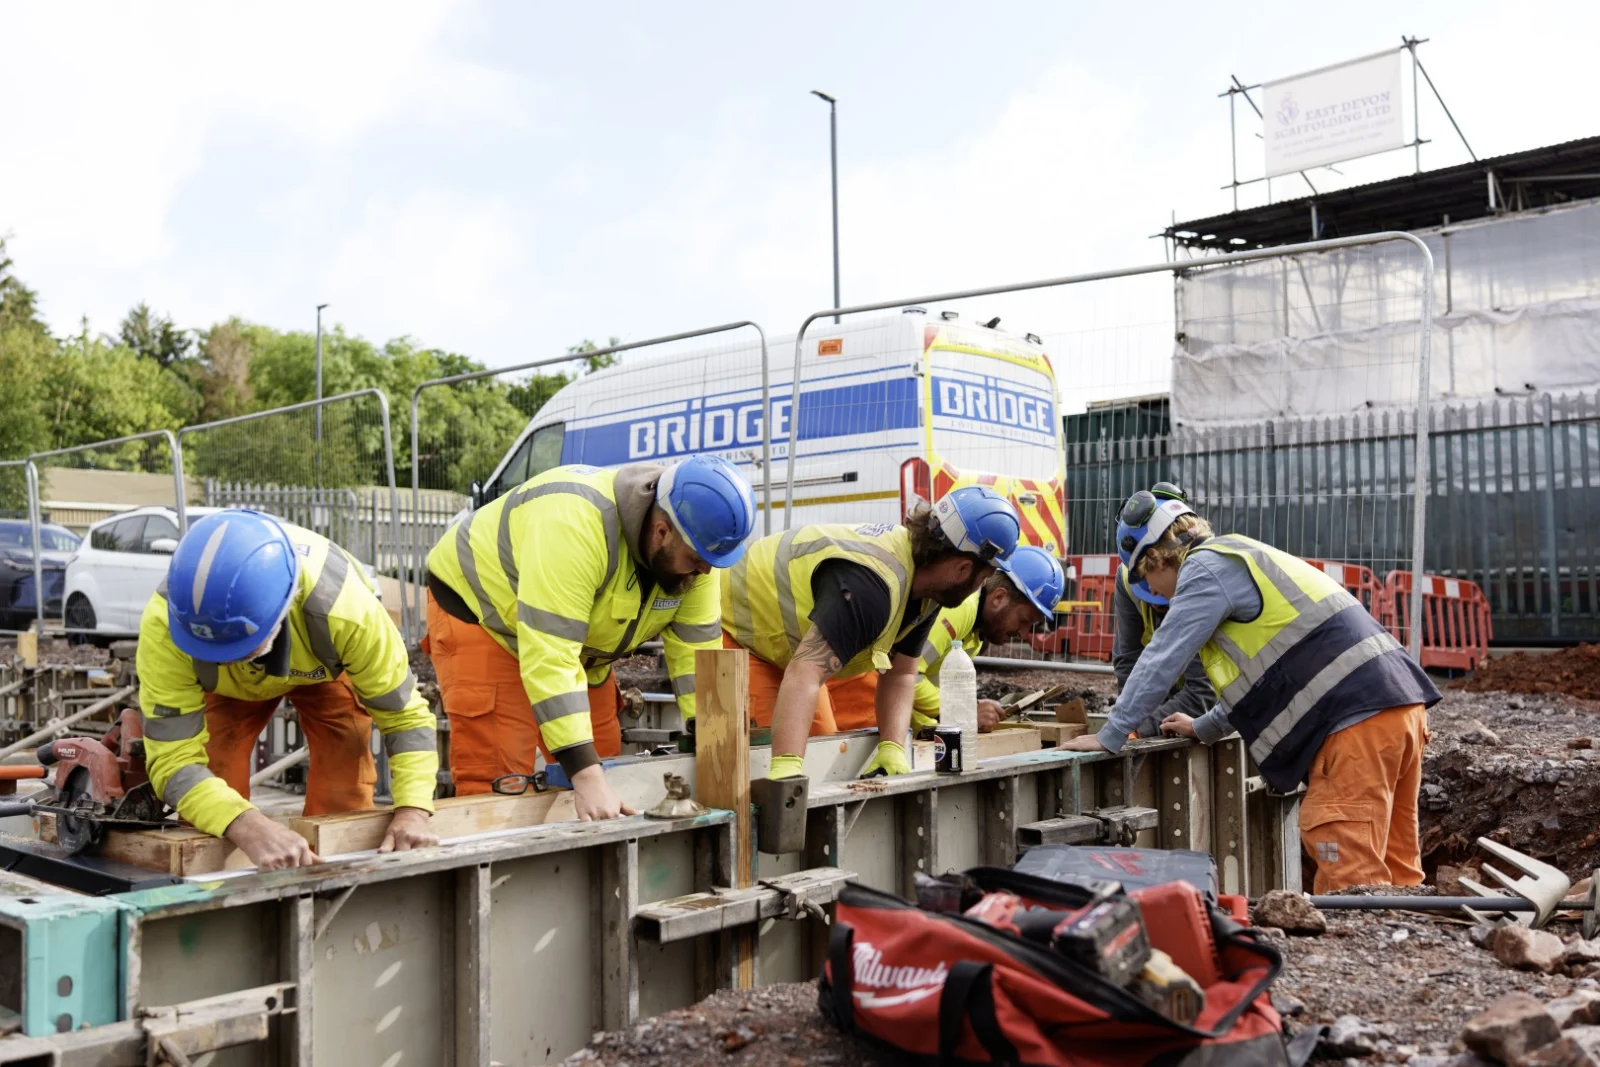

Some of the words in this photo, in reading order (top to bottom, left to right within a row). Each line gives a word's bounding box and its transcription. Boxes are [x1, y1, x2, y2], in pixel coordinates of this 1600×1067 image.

[1274, 111, 1363, 140] SCAFFOLDING
[1366, 104, 1391, 118] LTD
[1306, 105, 1338, 121] EAST
[1341, 91, 1391, 112] DEVON
[853, 942, 948, 990] Milwauk
